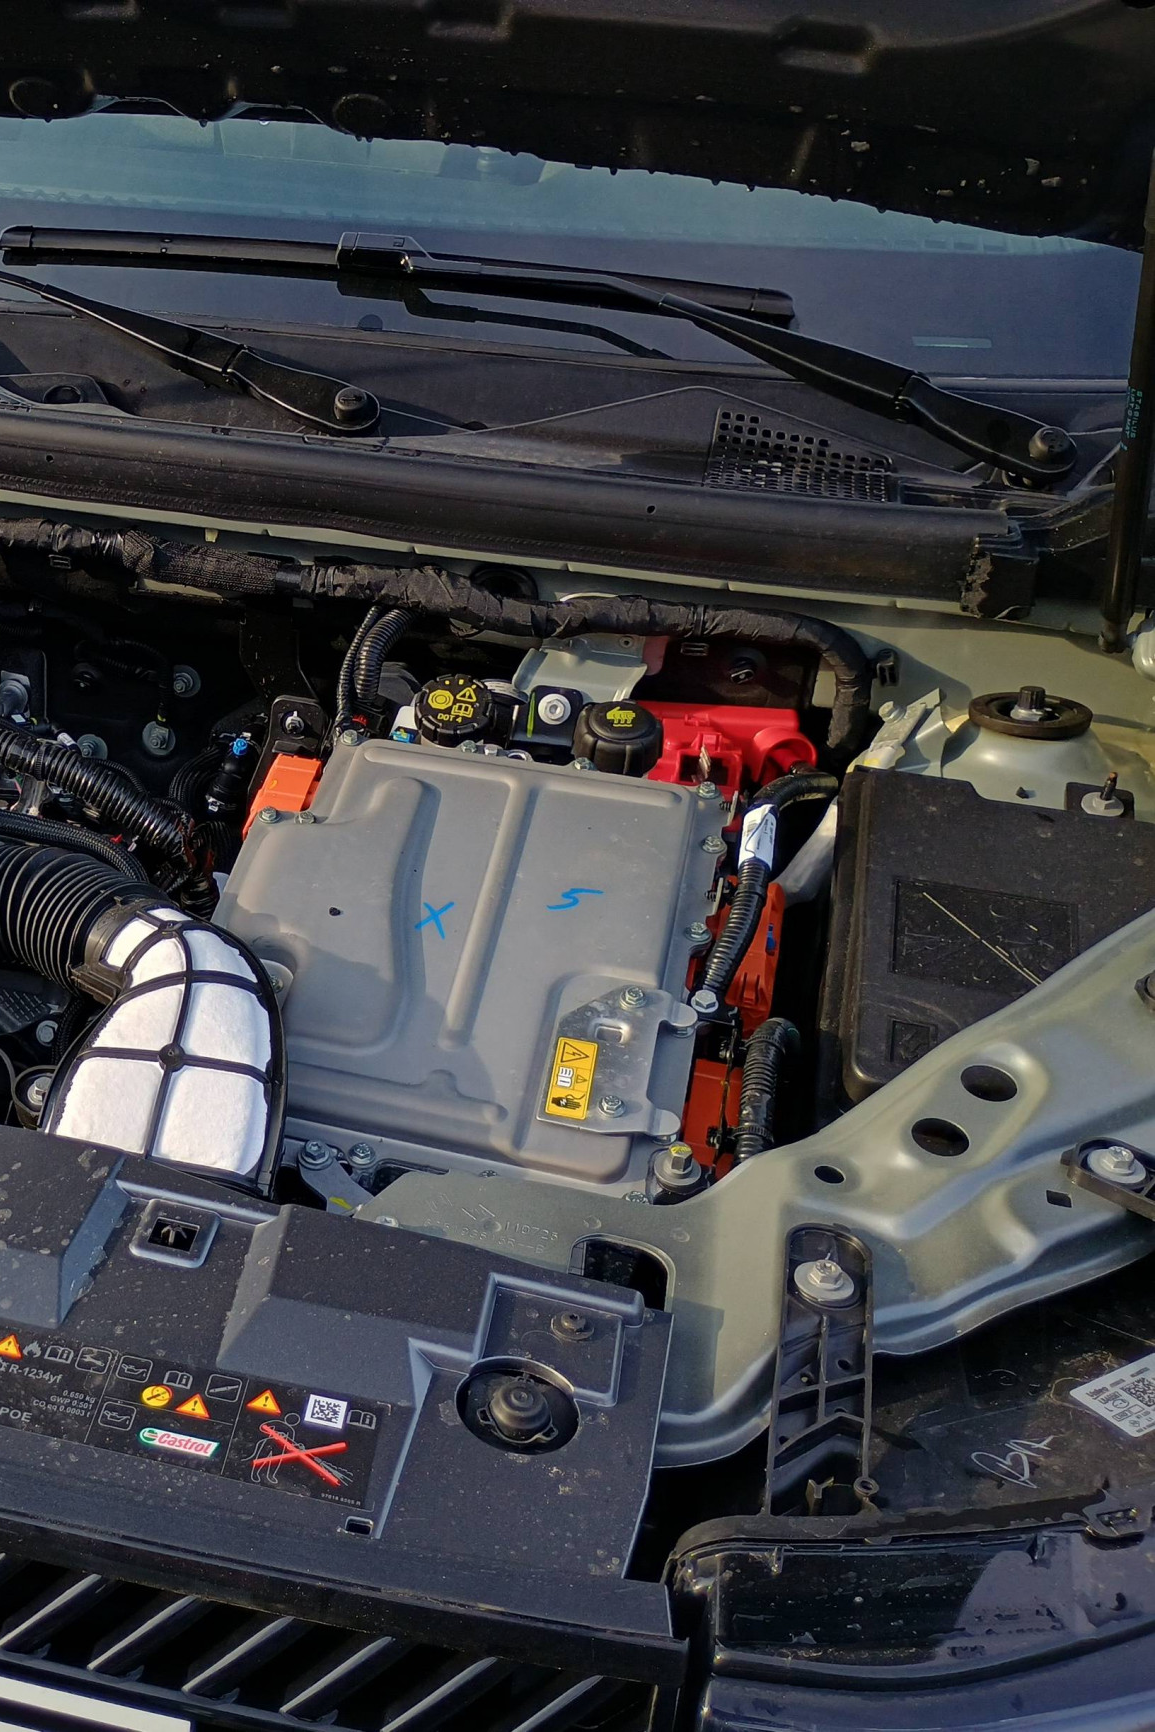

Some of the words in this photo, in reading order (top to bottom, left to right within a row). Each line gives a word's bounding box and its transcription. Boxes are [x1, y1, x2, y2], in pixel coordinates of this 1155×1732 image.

[437, 713, 455, 721] DOT
[9, 1364, 63, 1384] R-1234yf
[50, 1395, 71, 1405] GWP
[71, 1400, 93, 1410] 0.501
[62, 1390, 84, 1400] 0.650
[85, 1395, 96, 1404] kg
[59, 1405, 85, 1417] 0.0003
[158, 1433, 213, 1454] Castrol
